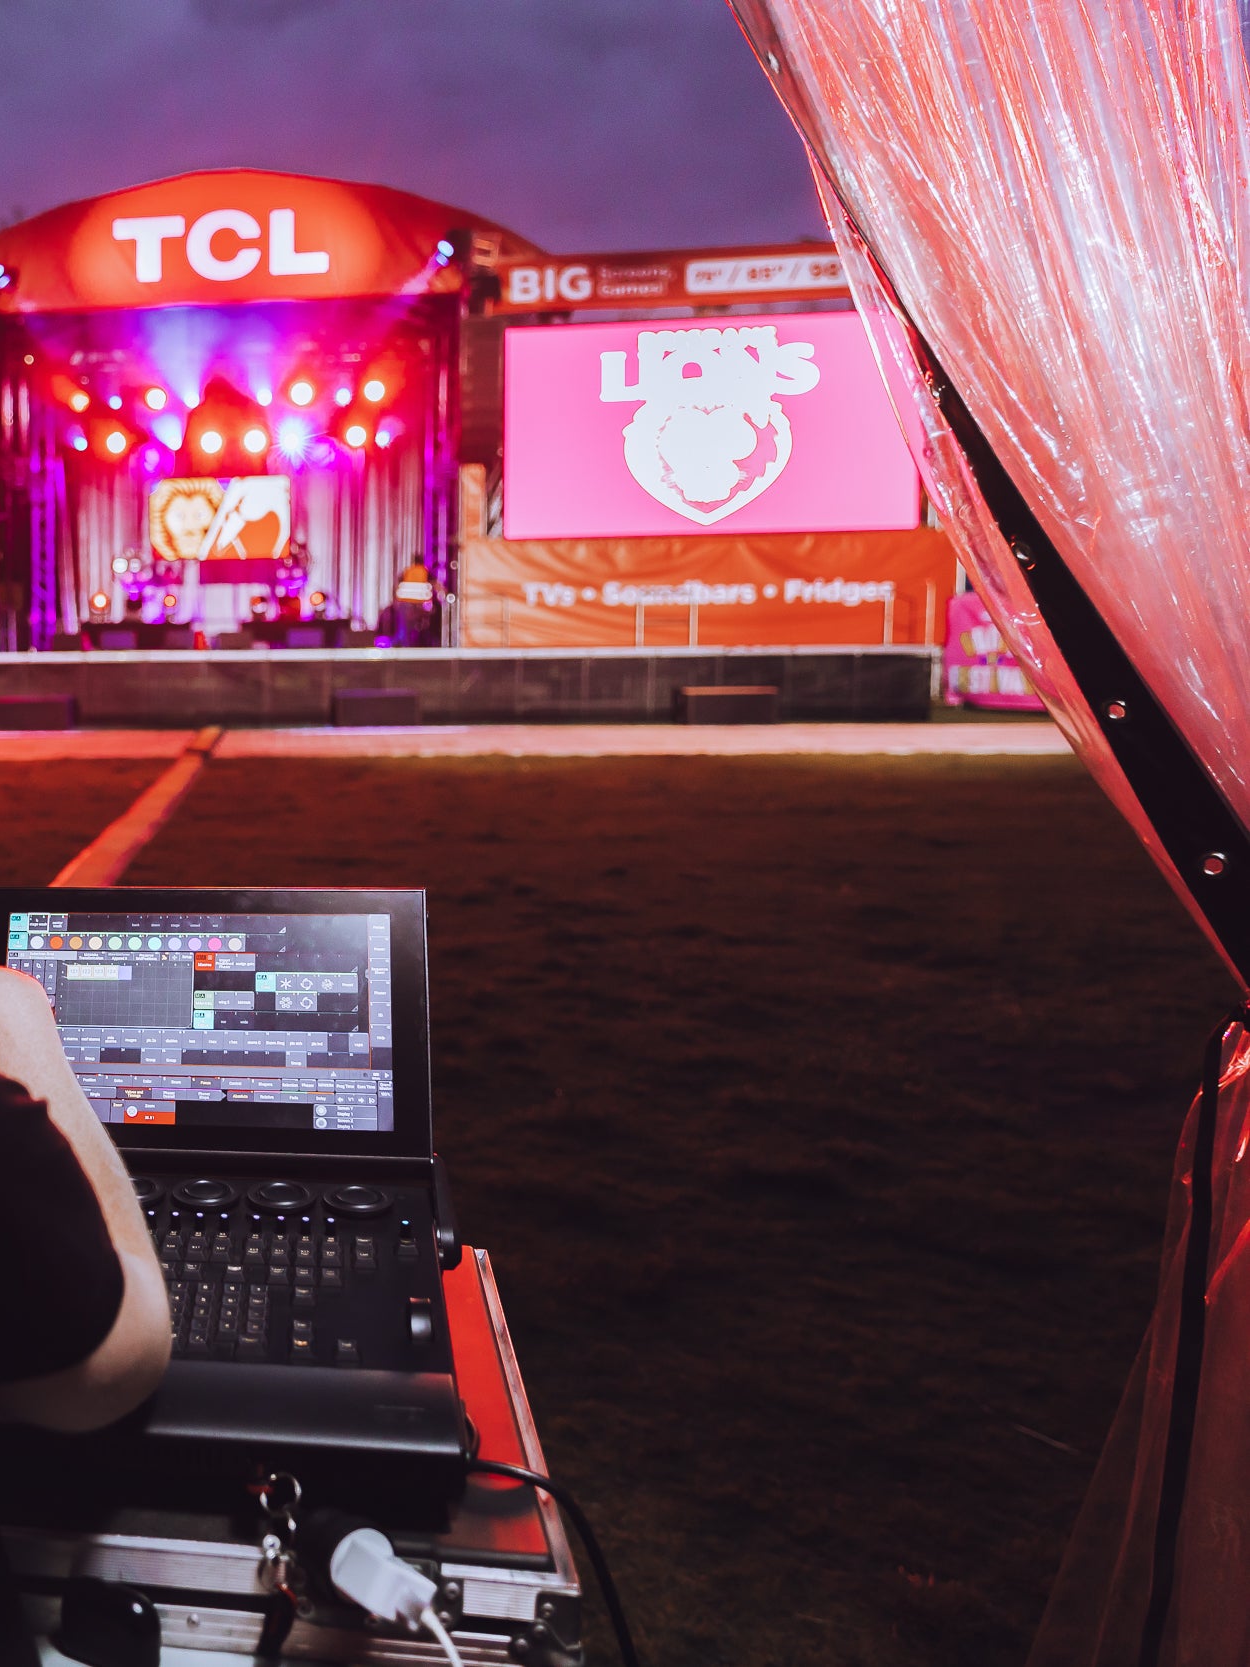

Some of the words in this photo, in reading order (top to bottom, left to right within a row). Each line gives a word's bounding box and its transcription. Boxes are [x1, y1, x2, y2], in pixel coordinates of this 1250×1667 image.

[112, 208, 330, 283] TCL
[509, 265, 593, 303] BIG
[522, 582, 576, 606] TVs
[784, 577, 896, 608] Fridges
